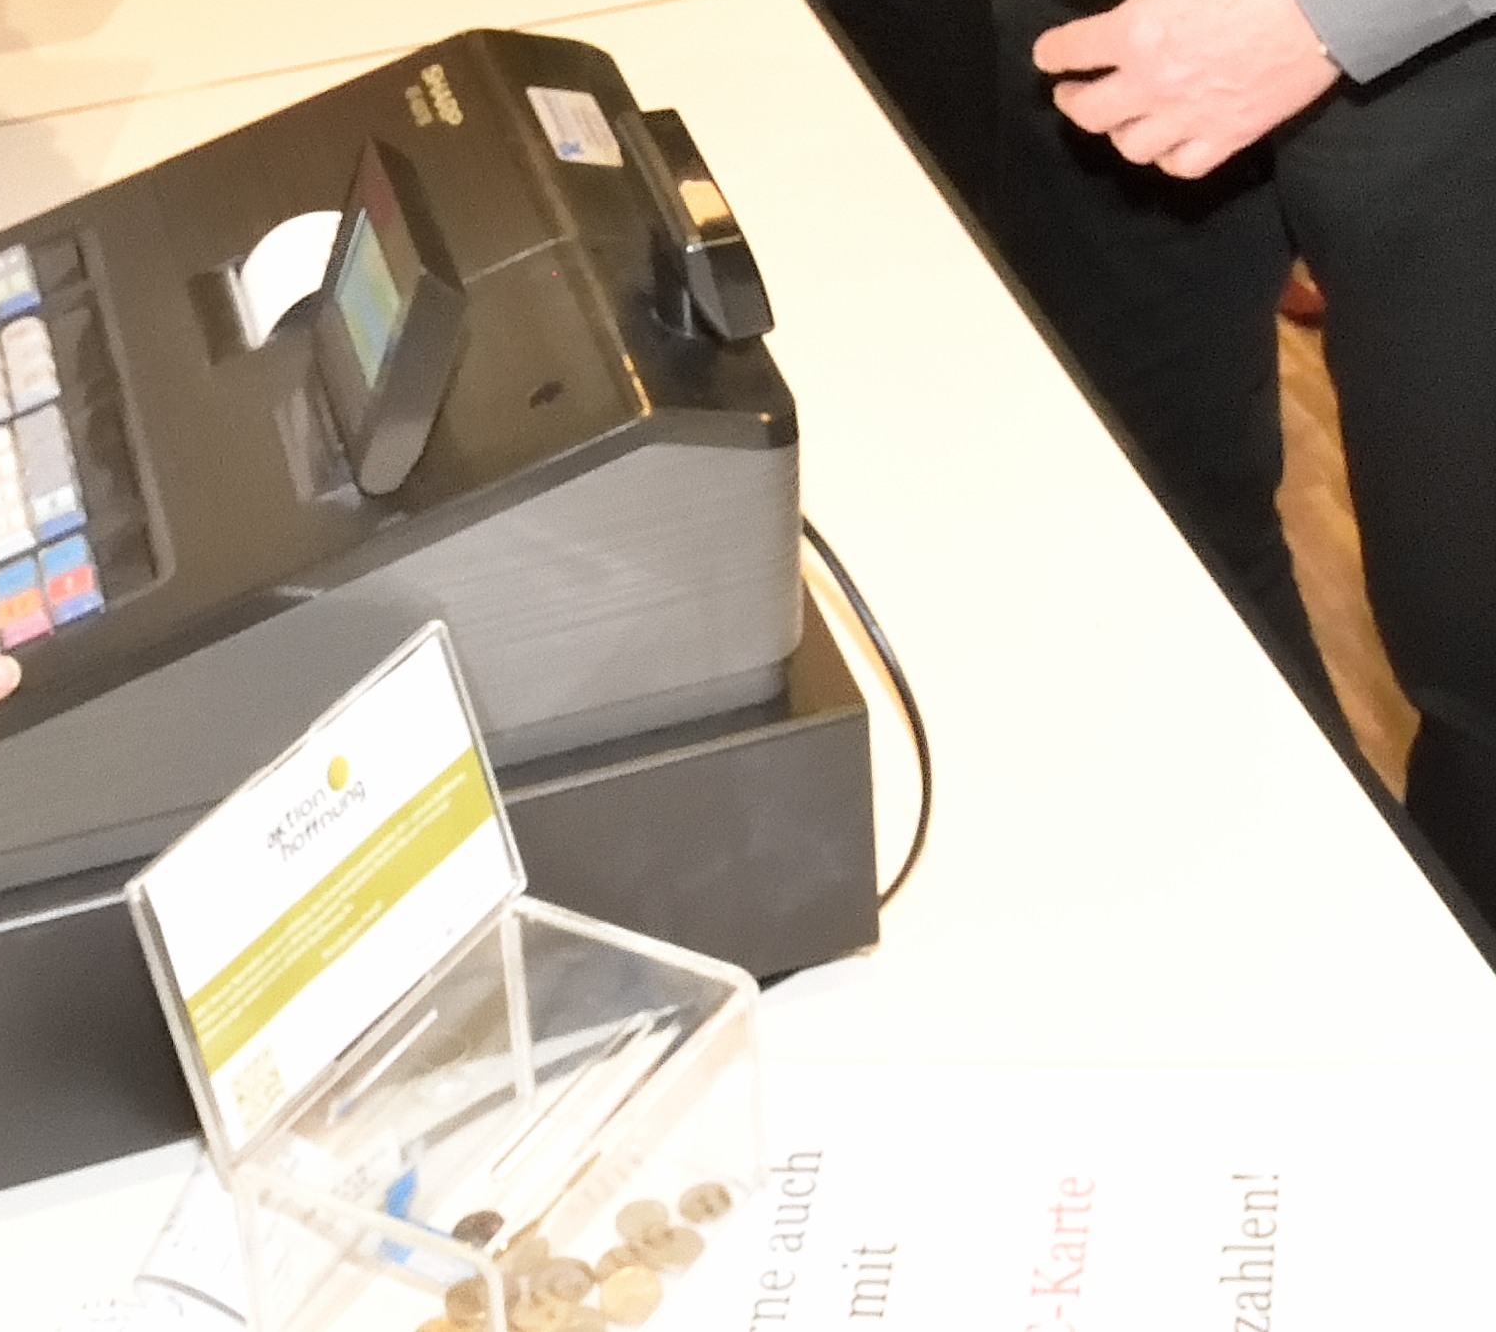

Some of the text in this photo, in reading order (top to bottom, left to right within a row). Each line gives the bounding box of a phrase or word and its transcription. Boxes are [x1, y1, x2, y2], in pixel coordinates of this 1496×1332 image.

[267, 788, 326, 849] aktion
[280, 780, 366, 862] hoffnung
[748, 1149, 823, 1332] ne auch
[841, 1243, 898, 1320] mit
[1218, 1173, 1280, 1332] zahlen!
